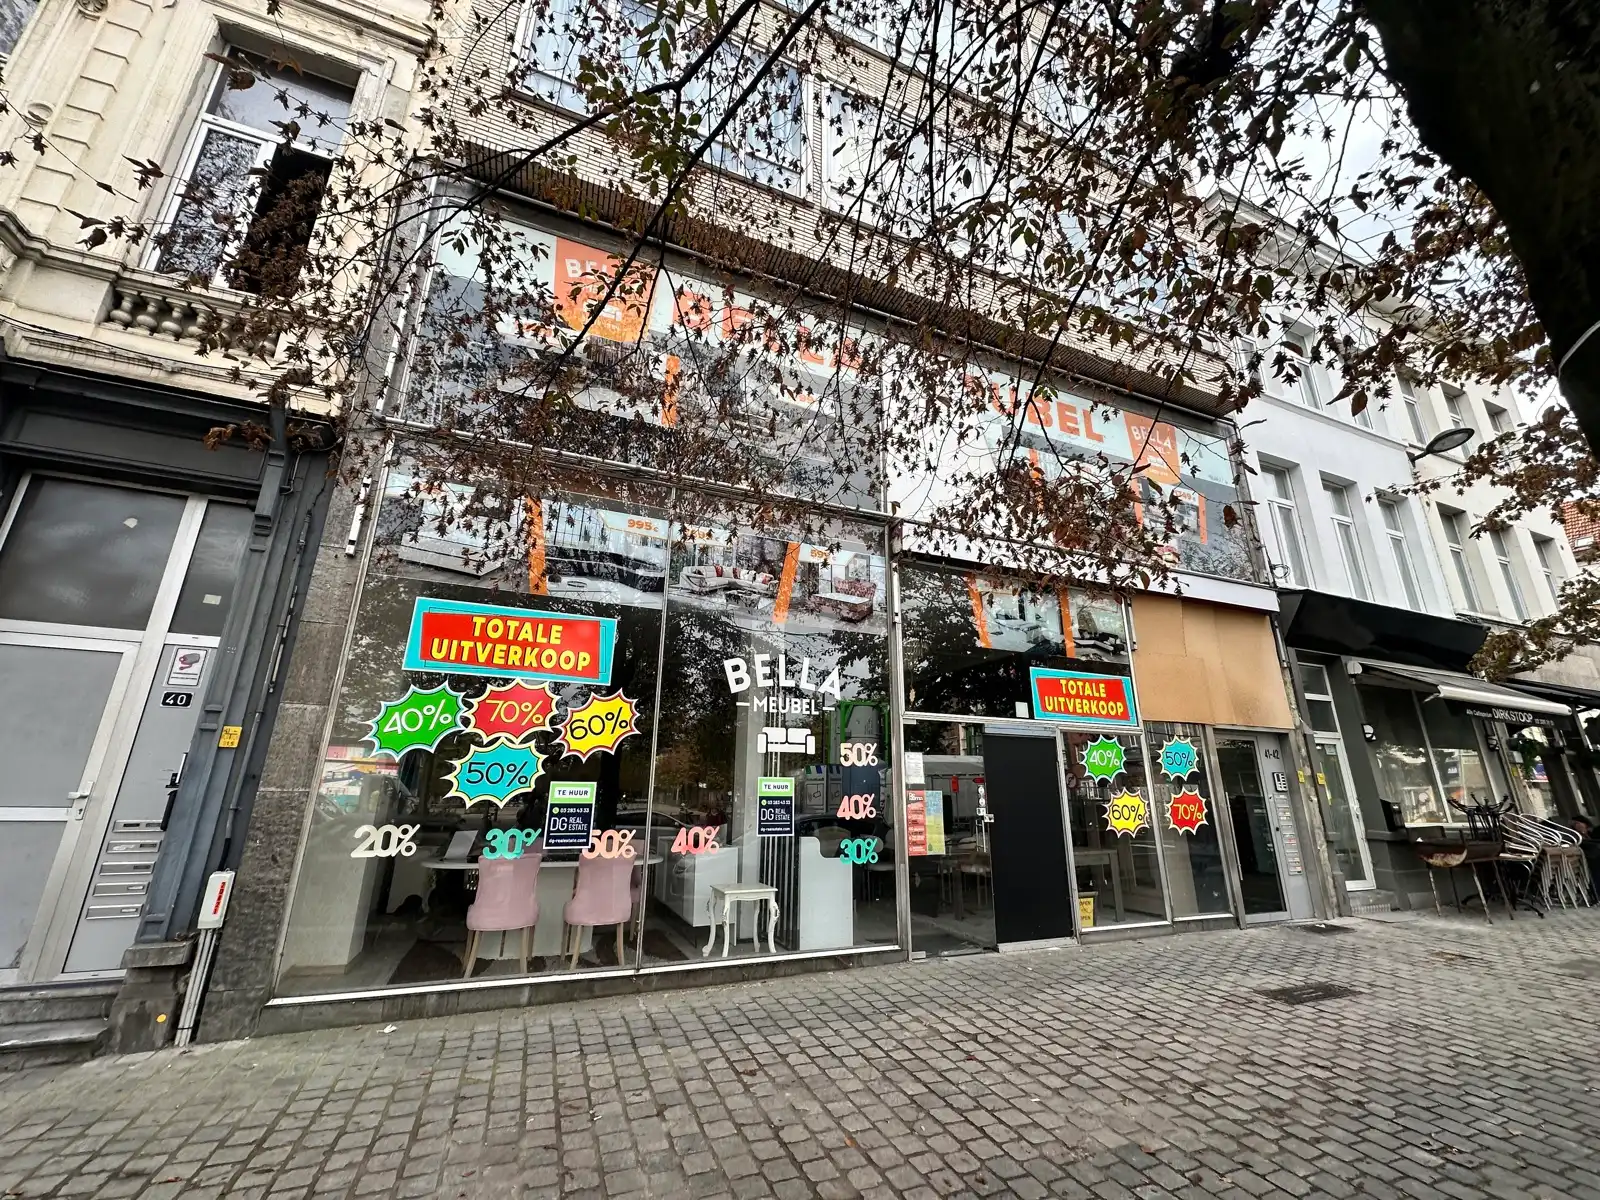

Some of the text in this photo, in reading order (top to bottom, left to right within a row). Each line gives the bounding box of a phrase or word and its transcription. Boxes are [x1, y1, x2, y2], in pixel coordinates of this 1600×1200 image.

[472, 616, 563, 644] TOTALE
[431, 638, 591, 671] UITVERKOOP
[724, 654, 841, 700] BELLA
[1060, 679, 1107, 698] TOTALE
[165, 693, 187, 705] 40
[753, 696, 819, 715] MEUBEL
[1044, 696, 1124, 716] UITVERKOOP
[383, 699, 452, 735] 40%
[485, 700, 544, 726] 70%
[569, 706, 629, 740] 60%
[840, 743, 878, 767] 50%
[1090, 750, 1120, 766] 40%
[1165, 751, 1194, 769] 50%
[465, 761, 529, 788] 50%
[760, 808, 774, 821] DG
[837, 793, 877, 820] 40%
[1111, 804, 1144, 822] 60%
[1173, 803, 1202, 820] 70%
[550, 817, 568, 831] DG
[350, 823, 421, 858] 20%
[581, 829, 637, 859] 50%
[671, 826, 721, 855] 40%
[840, 838, 879, 865] 30%
